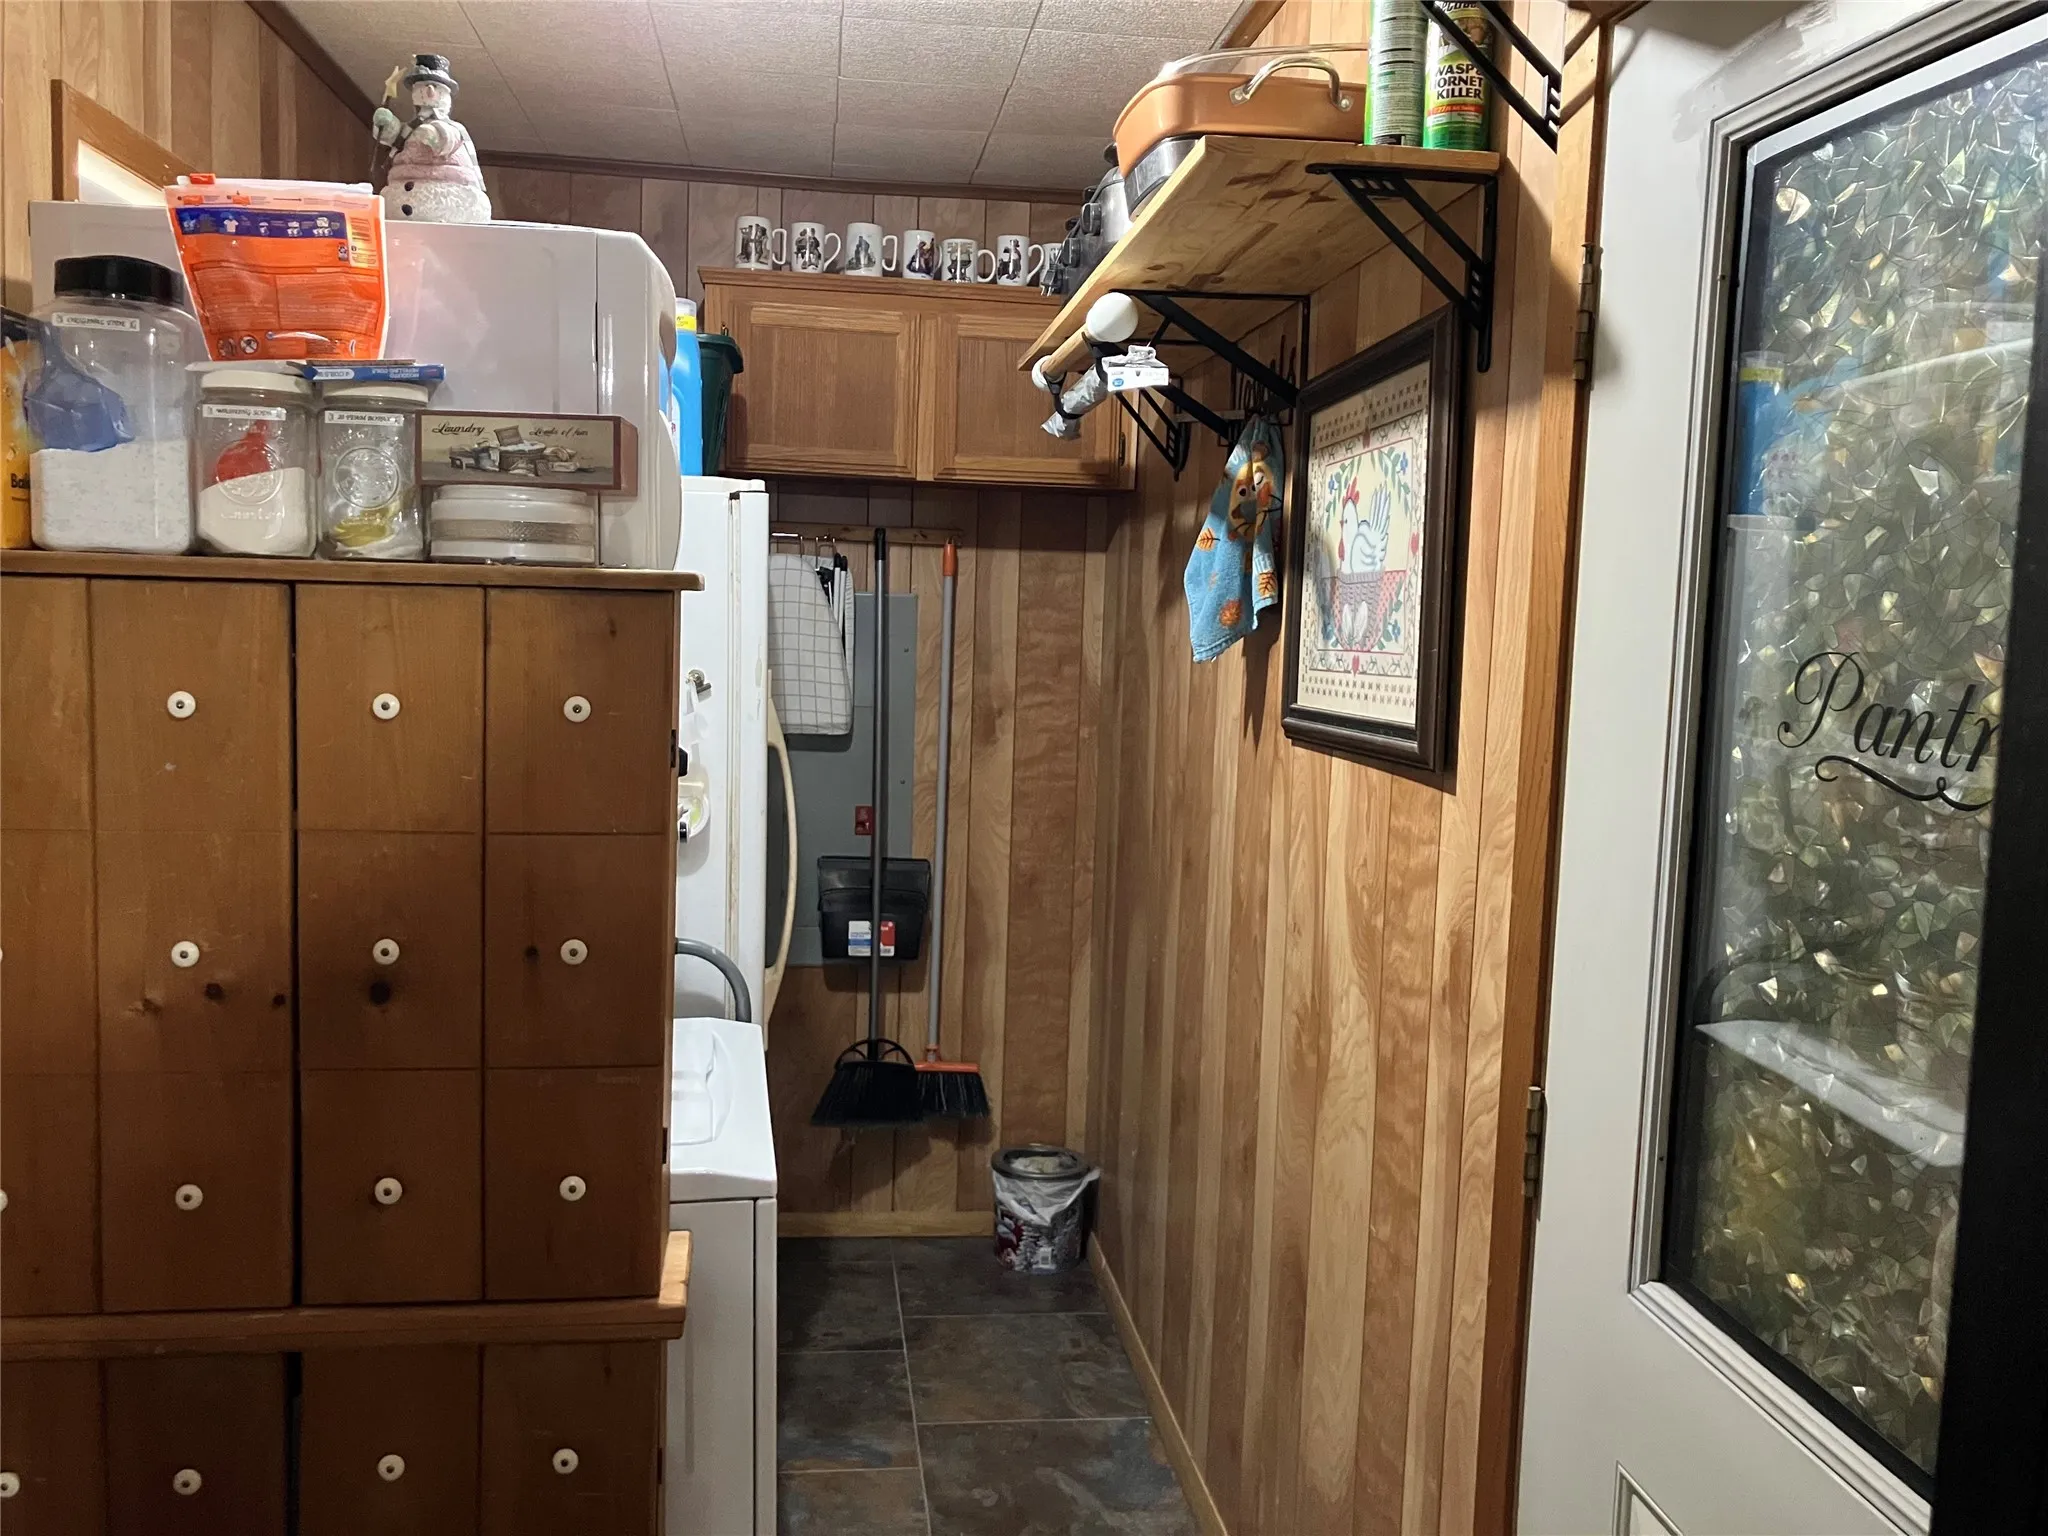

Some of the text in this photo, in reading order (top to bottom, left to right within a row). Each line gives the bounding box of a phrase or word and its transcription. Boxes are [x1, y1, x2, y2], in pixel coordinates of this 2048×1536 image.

[1436, 87, 1483, 101] KILLER
[431, 421, 485, 436] Laundry
[1777, 651, 2001, 772] Pantr
